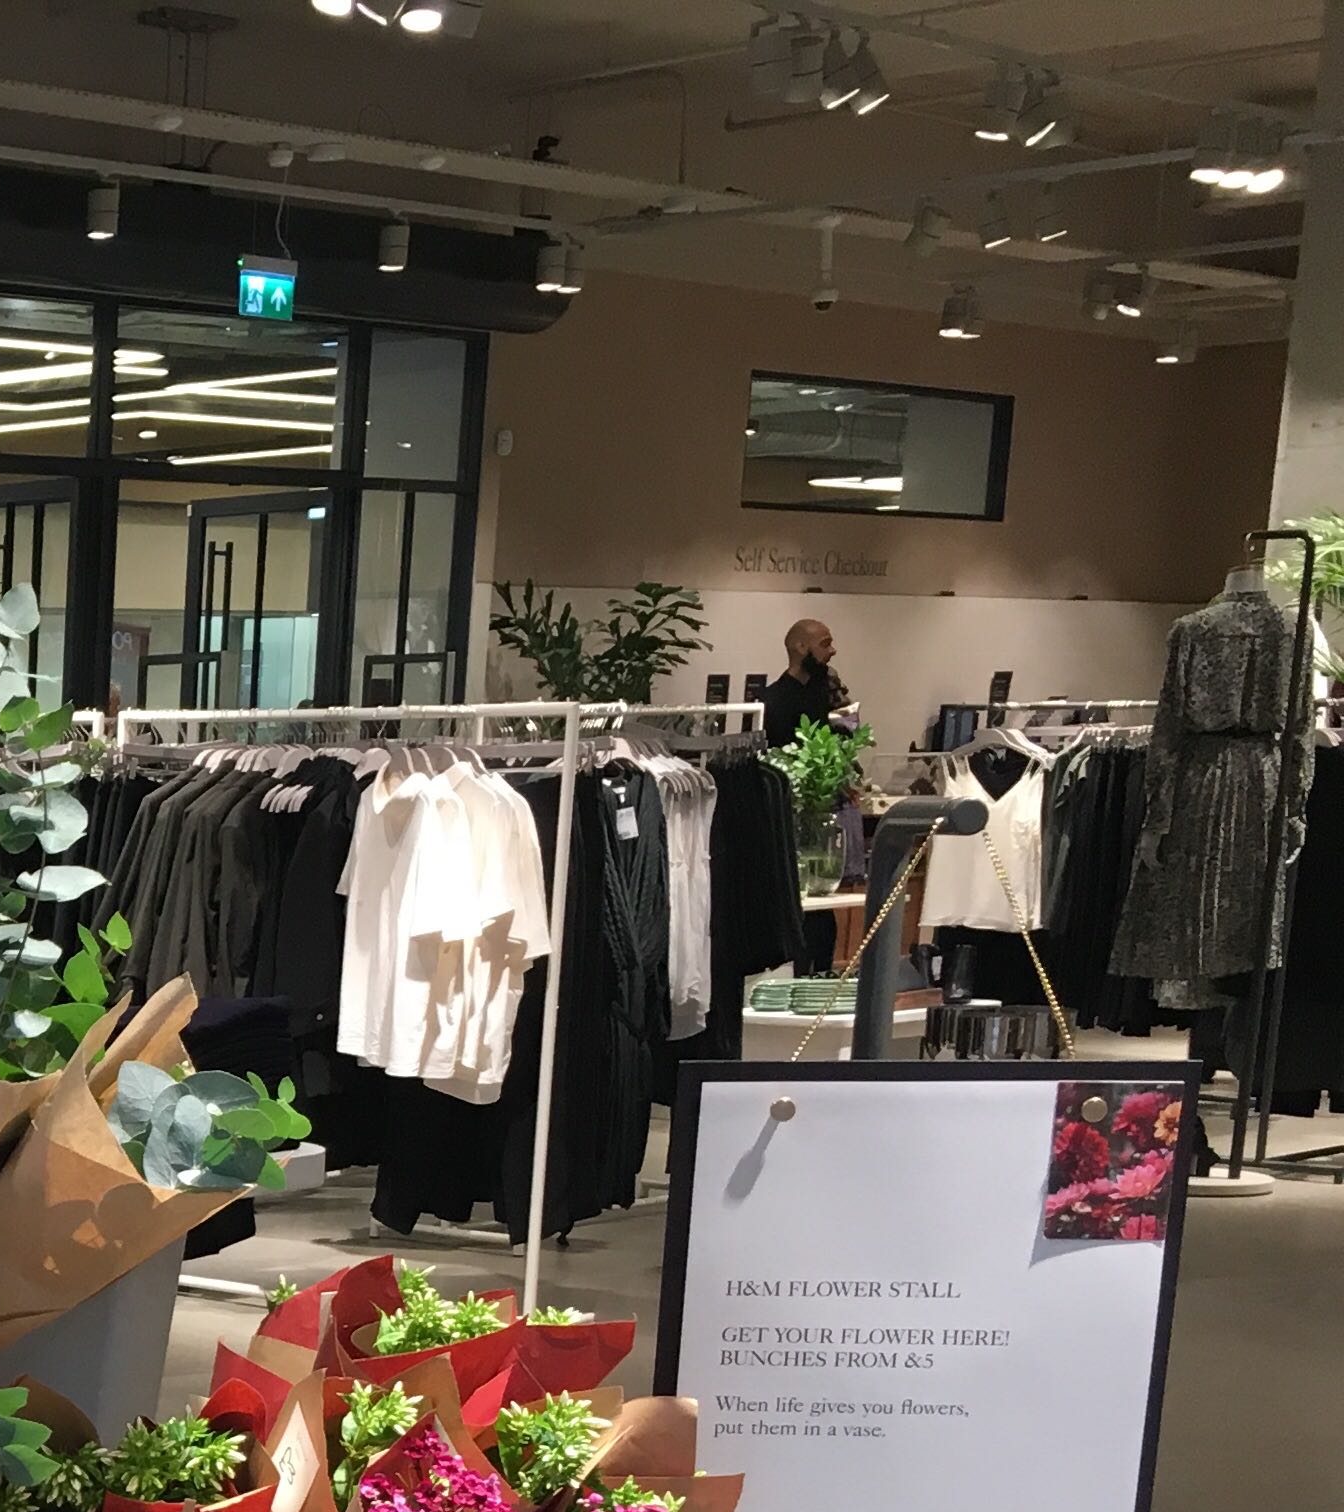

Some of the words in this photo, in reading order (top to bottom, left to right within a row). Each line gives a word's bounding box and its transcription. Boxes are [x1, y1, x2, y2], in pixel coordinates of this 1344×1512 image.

[734, 545, 764, 573] Self
[767, 547, 819, 574] Service
[824, 550, 889, 577] Checkout
[725, 1280, 781, 1297] H&M
[788, 1281, 881, 1298] FLOWER
[888, 1282, 961, 1299] STALL
[721, 1327, 770, 1343] GET
[775, 1328, 833, 1344] YOUR
[841, 1329, 934, 1345] FLOWER
[942, 1330, 1010, 1346] HERE!
[720, 1350, 827, 1367] BUNCHES
[834, 1352, 897, 1368] FROM
[904, 1353, 933, 1369] &5
[714, 1395, 769, 1412] When
[776, 1397, 803, 1413] life
[810, 1399, 855, 1416] gives
[863, 1403, 893, 1417] you
[901, 1399, 969, 1418] flowers,
[714, 1423, 743, 1437] put
[751, 1421, 796, 1435] them
[803, 1422, 820, 1436] in
[828, 1426, 837, 1437] a
[844, 1425, 886, 1438] vase.
